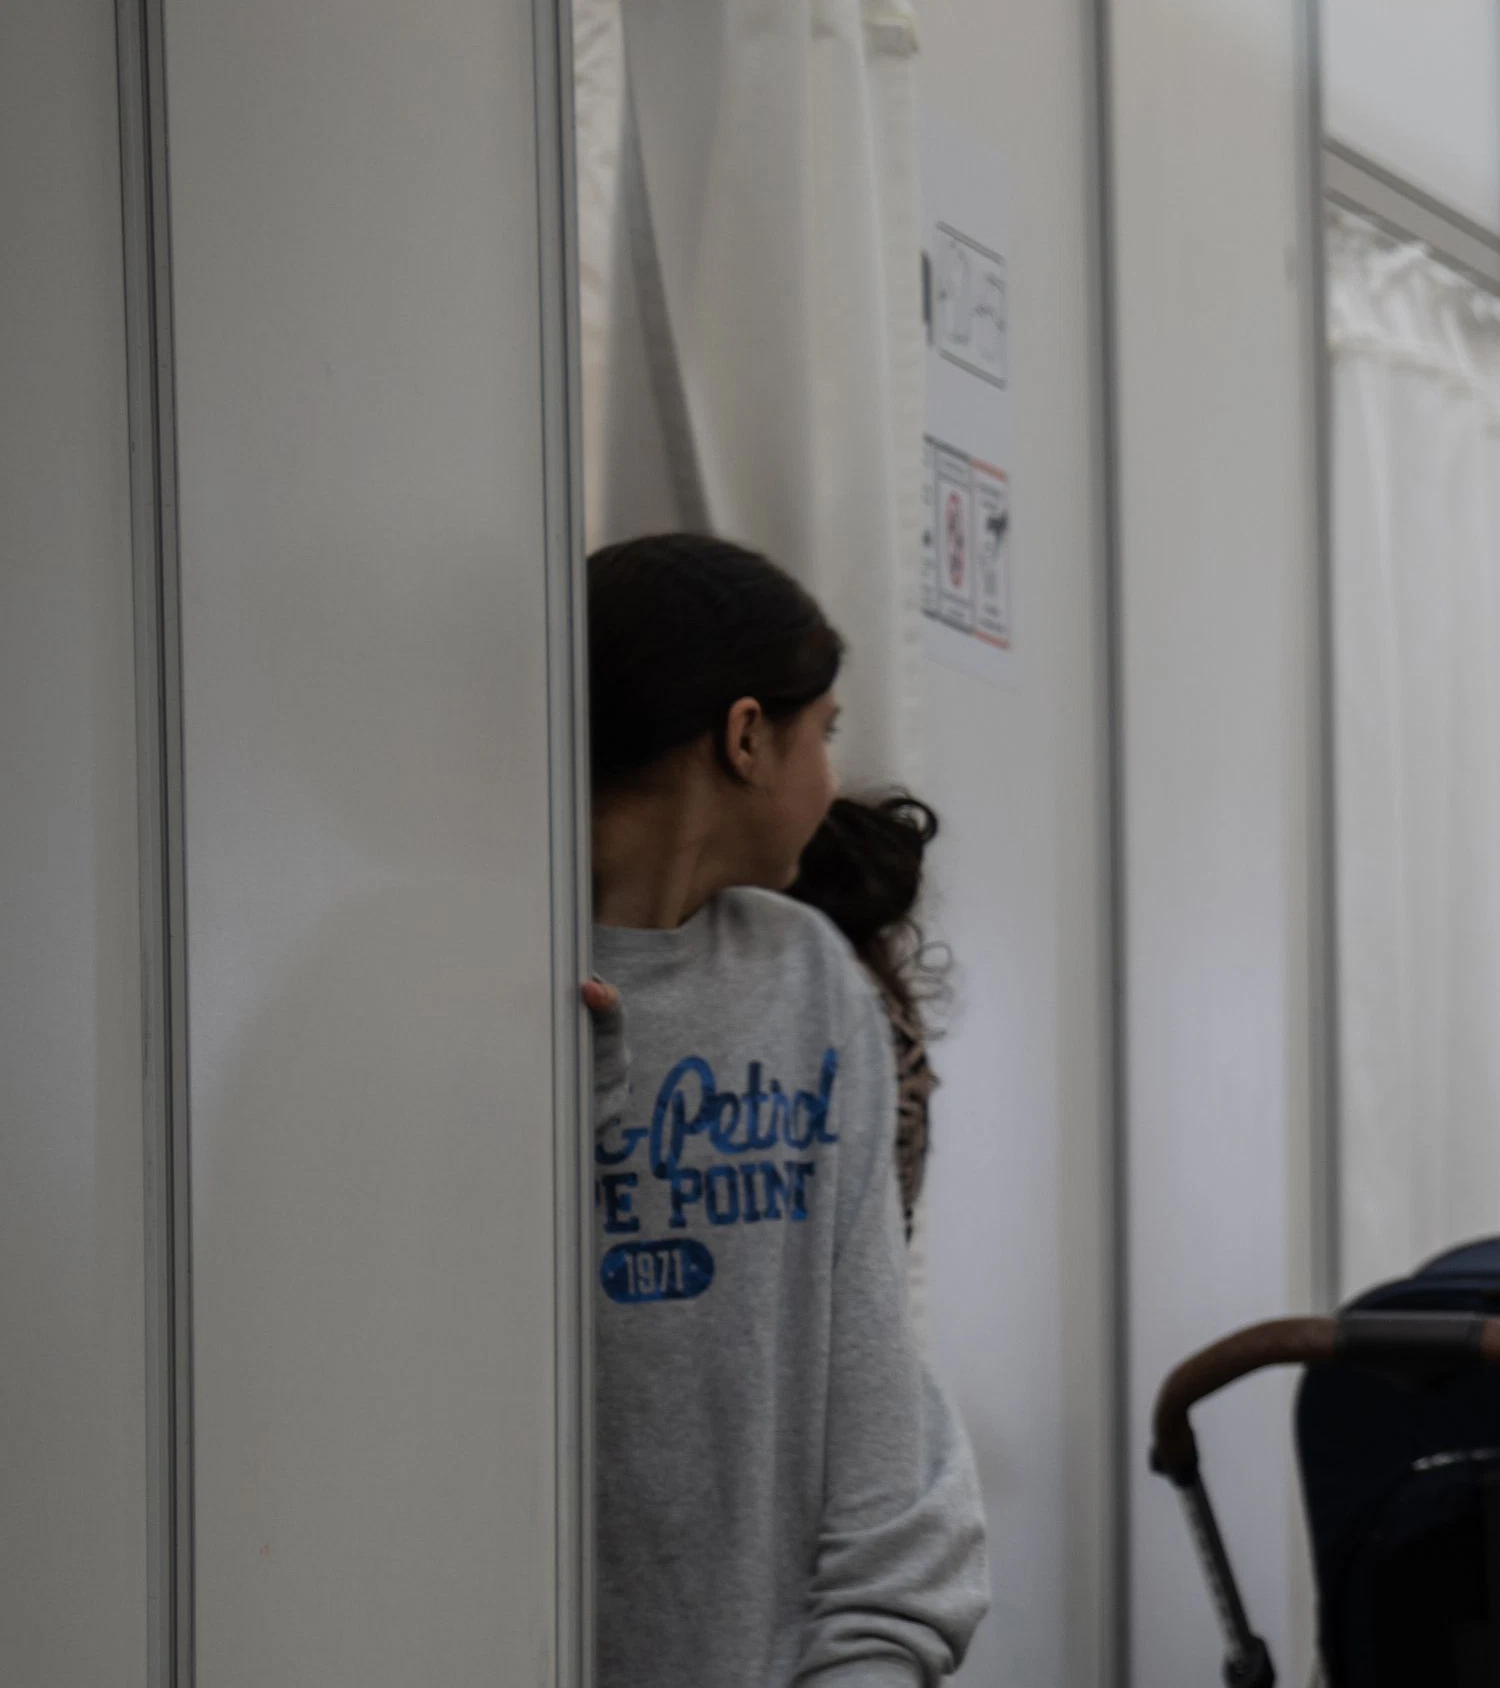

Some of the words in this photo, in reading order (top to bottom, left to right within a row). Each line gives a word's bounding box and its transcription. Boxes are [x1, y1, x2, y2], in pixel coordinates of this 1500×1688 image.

[649, 1047, 839, 1179] Petrol
[669, 1160, 815, 1229] POINT
[625, 1249, 685, 1295] 1971
